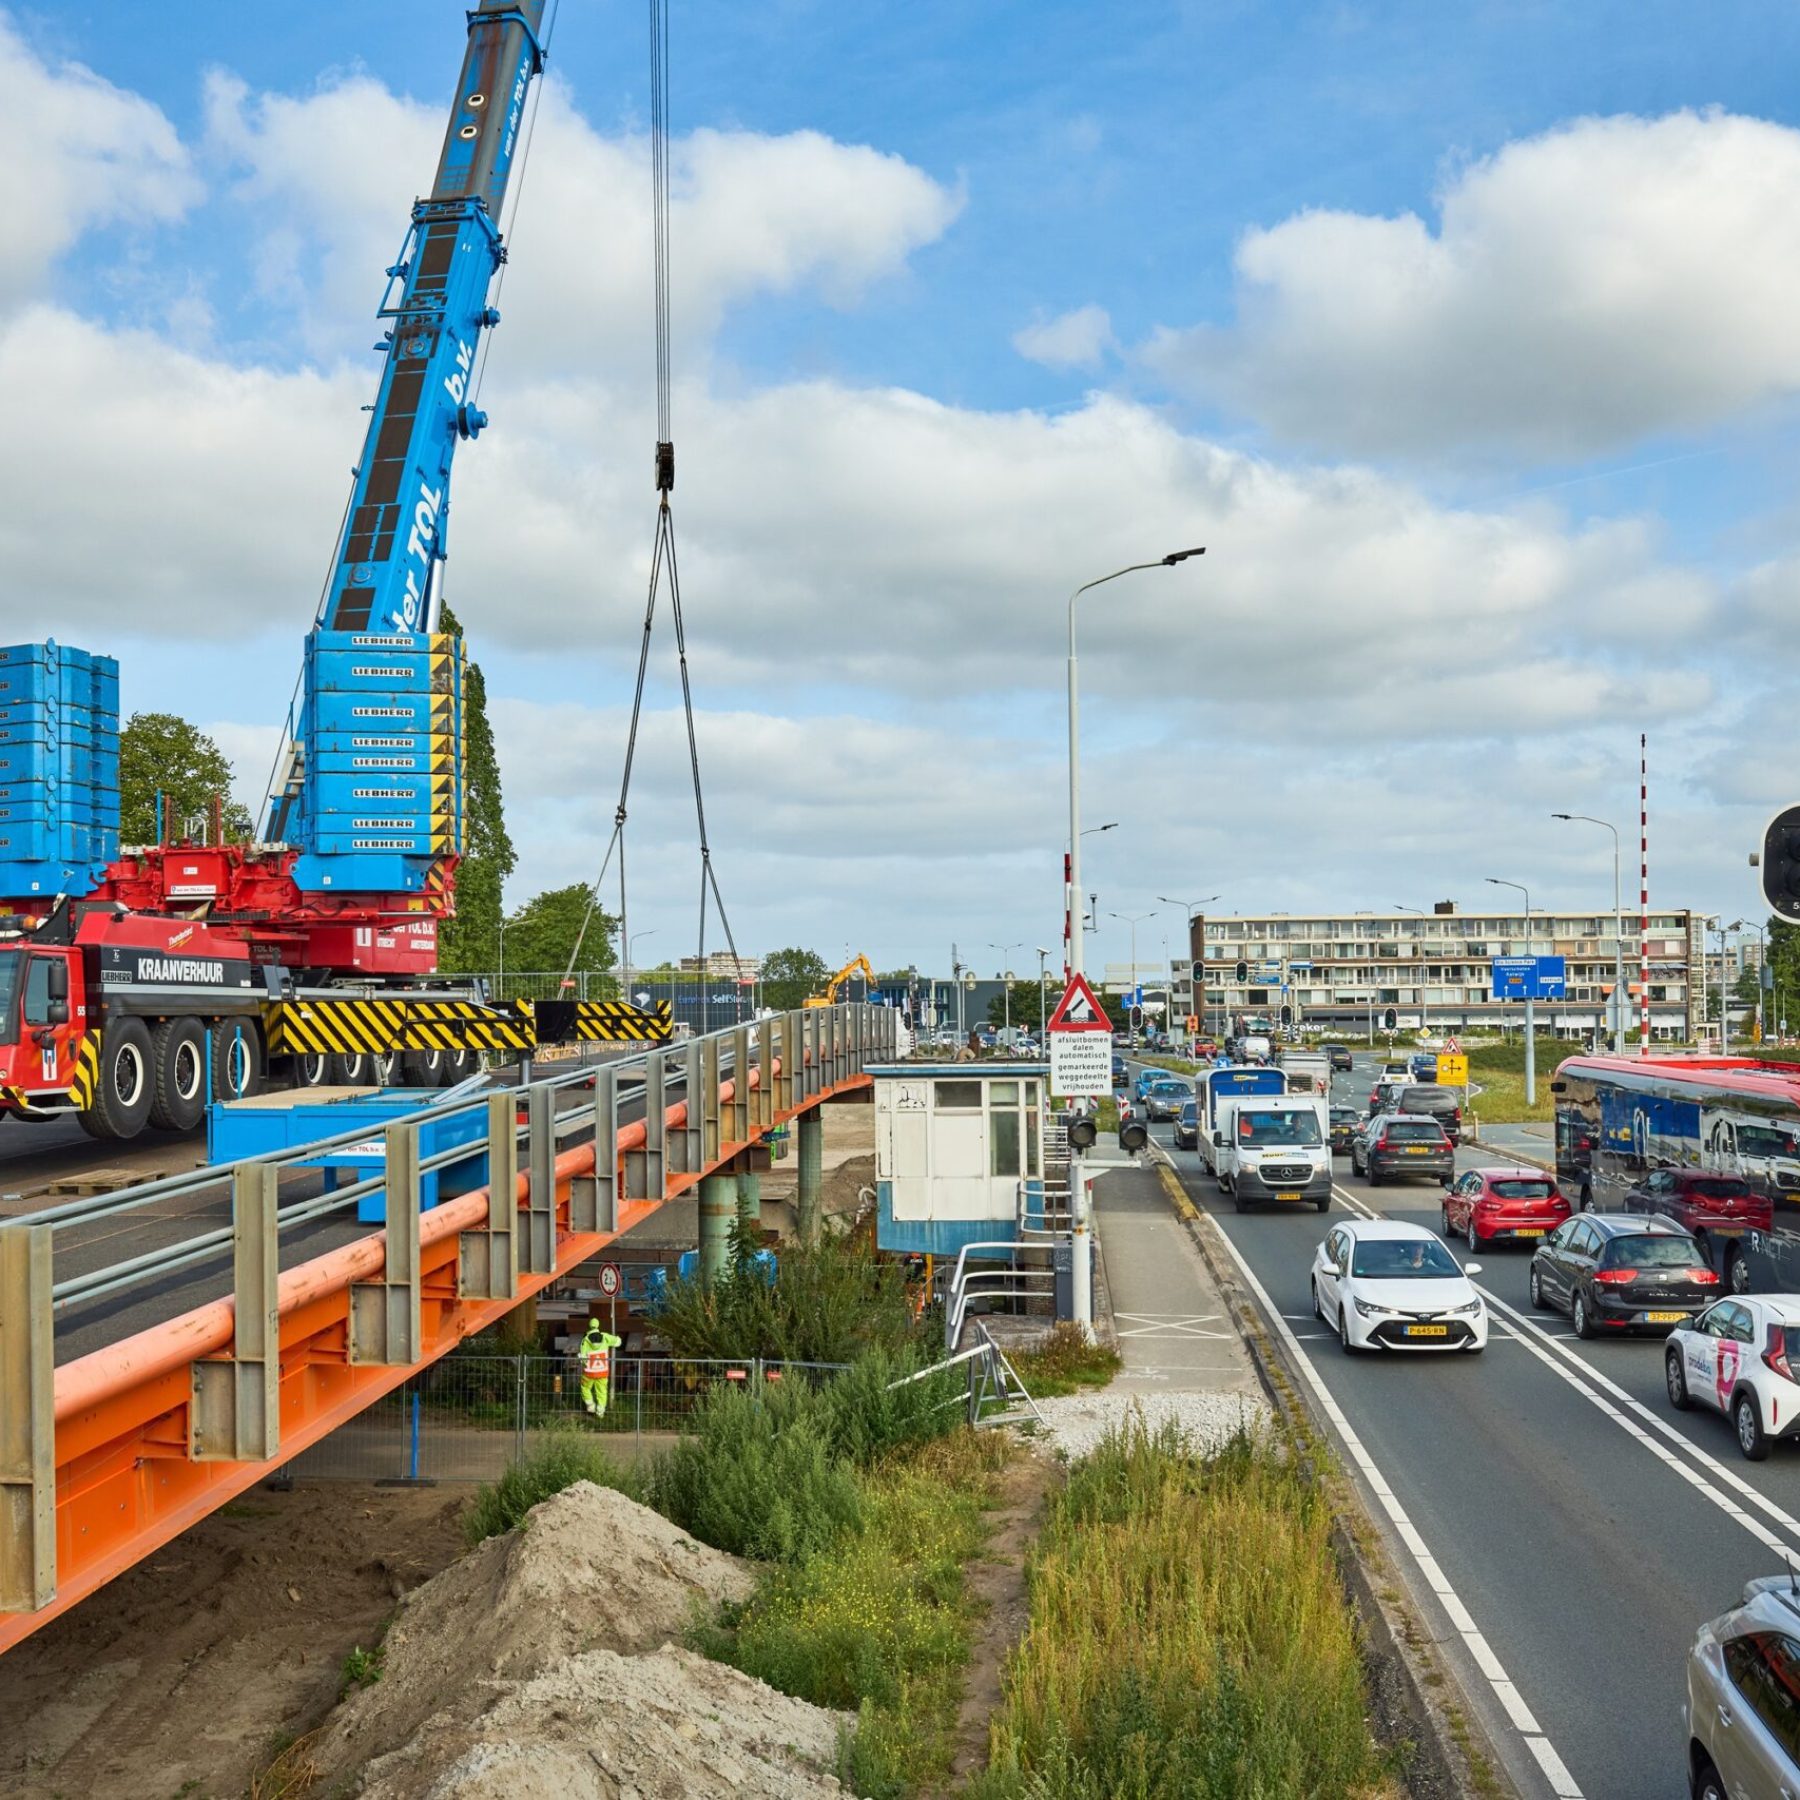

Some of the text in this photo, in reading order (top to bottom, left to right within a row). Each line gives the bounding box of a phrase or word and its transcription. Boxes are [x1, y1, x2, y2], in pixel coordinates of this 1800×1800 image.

[514, 80, 525, 105] TOL
[408, 482, 442, 564] TOL
[444, 339, 473, 404] b.v.
[353, 637, 412, 645] LIEBHERR
[353, 668, 412, 676] LIEBHERR
[353, 708, 413, 716] LIEBHERR
[138, 957, 223, 983] KRAANVERHUUR
[102, 971, 132, 982] LIEBHERR
[1062, 1083, 1104, 1091] vrijhouden
[1410, 1327, 1445, 1335] P-645-RN
